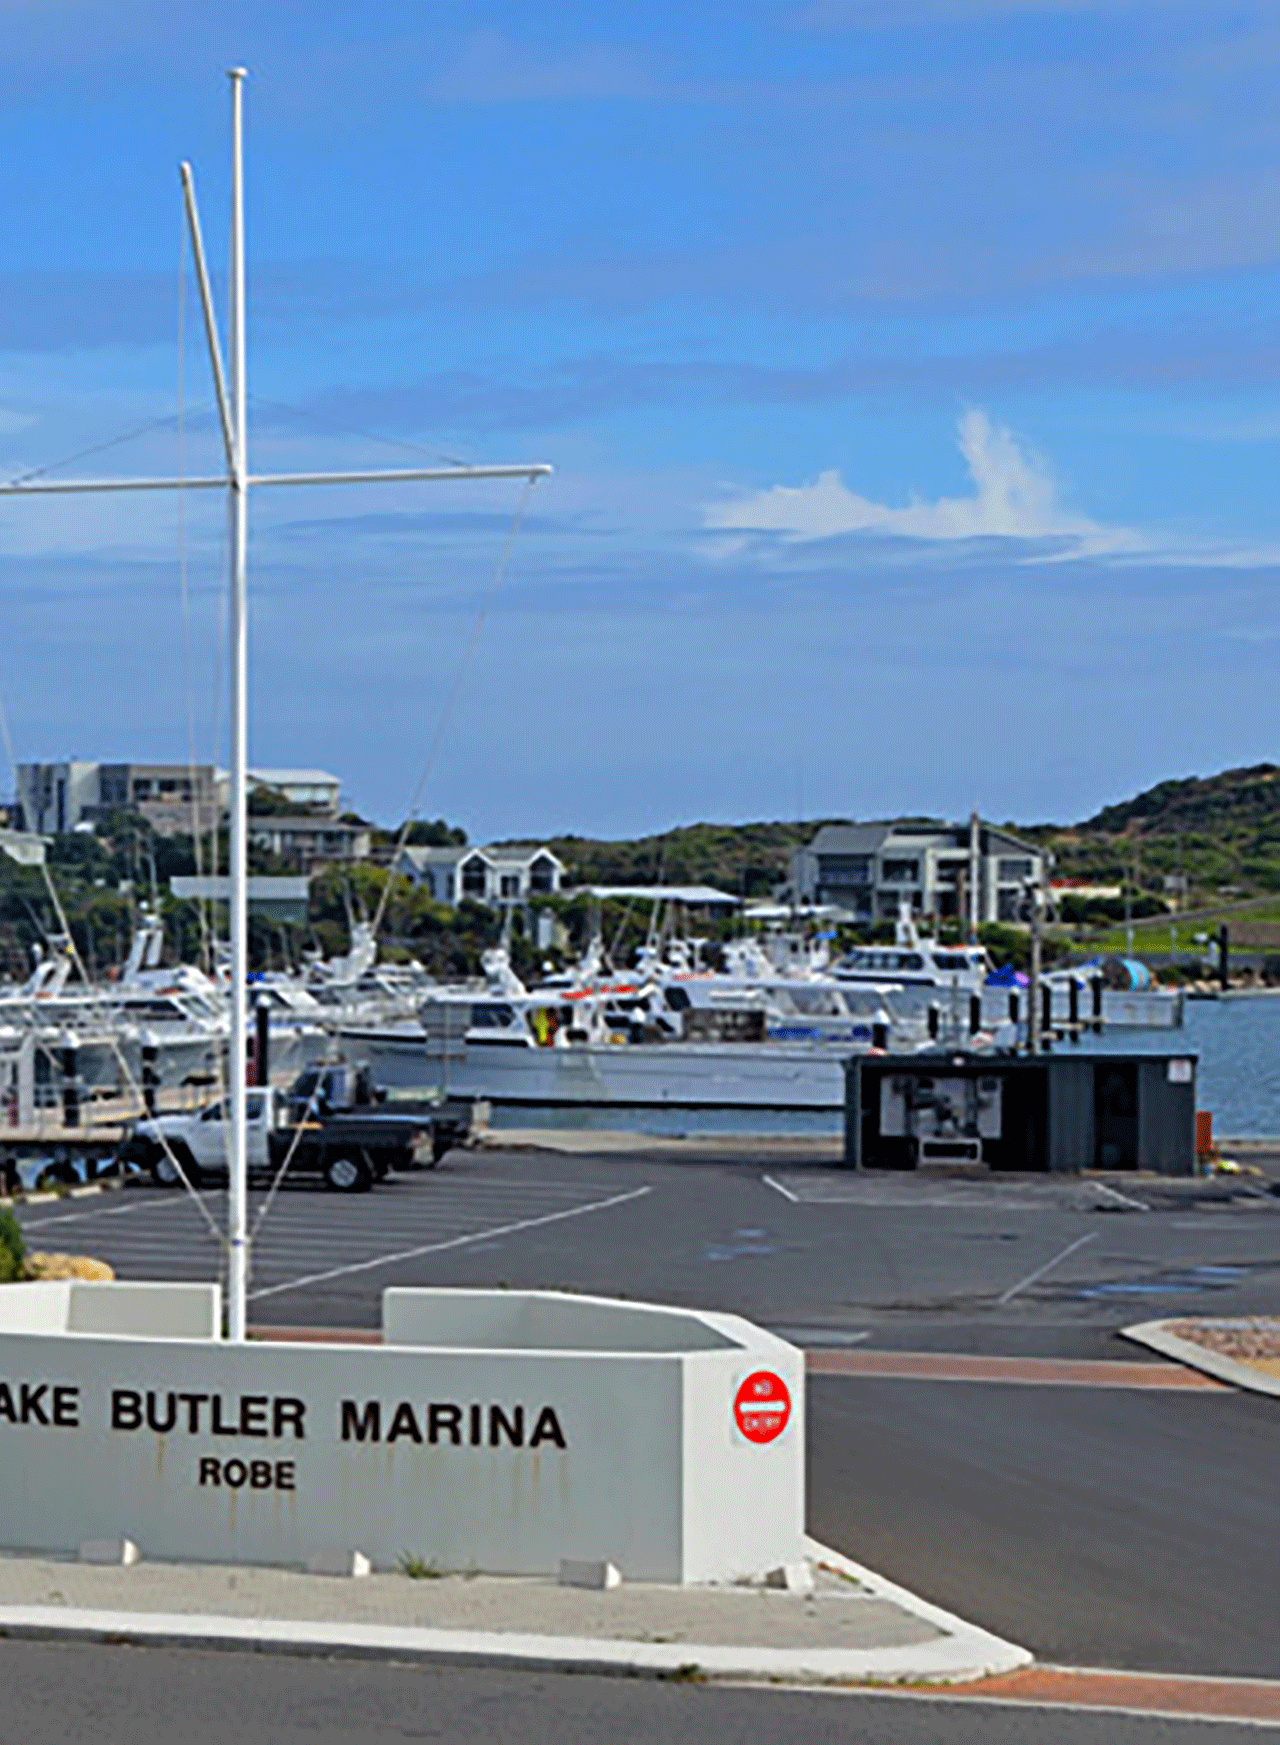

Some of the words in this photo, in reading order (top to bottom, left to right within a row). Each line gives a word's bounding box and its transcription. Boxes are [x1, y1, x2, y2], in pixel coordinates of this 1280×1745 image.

[111, 1389, 306, 1440] BUTLER
[341, 1400, 567, 1450] MARINA
[199, 1457, 296, 1491] ROBE
